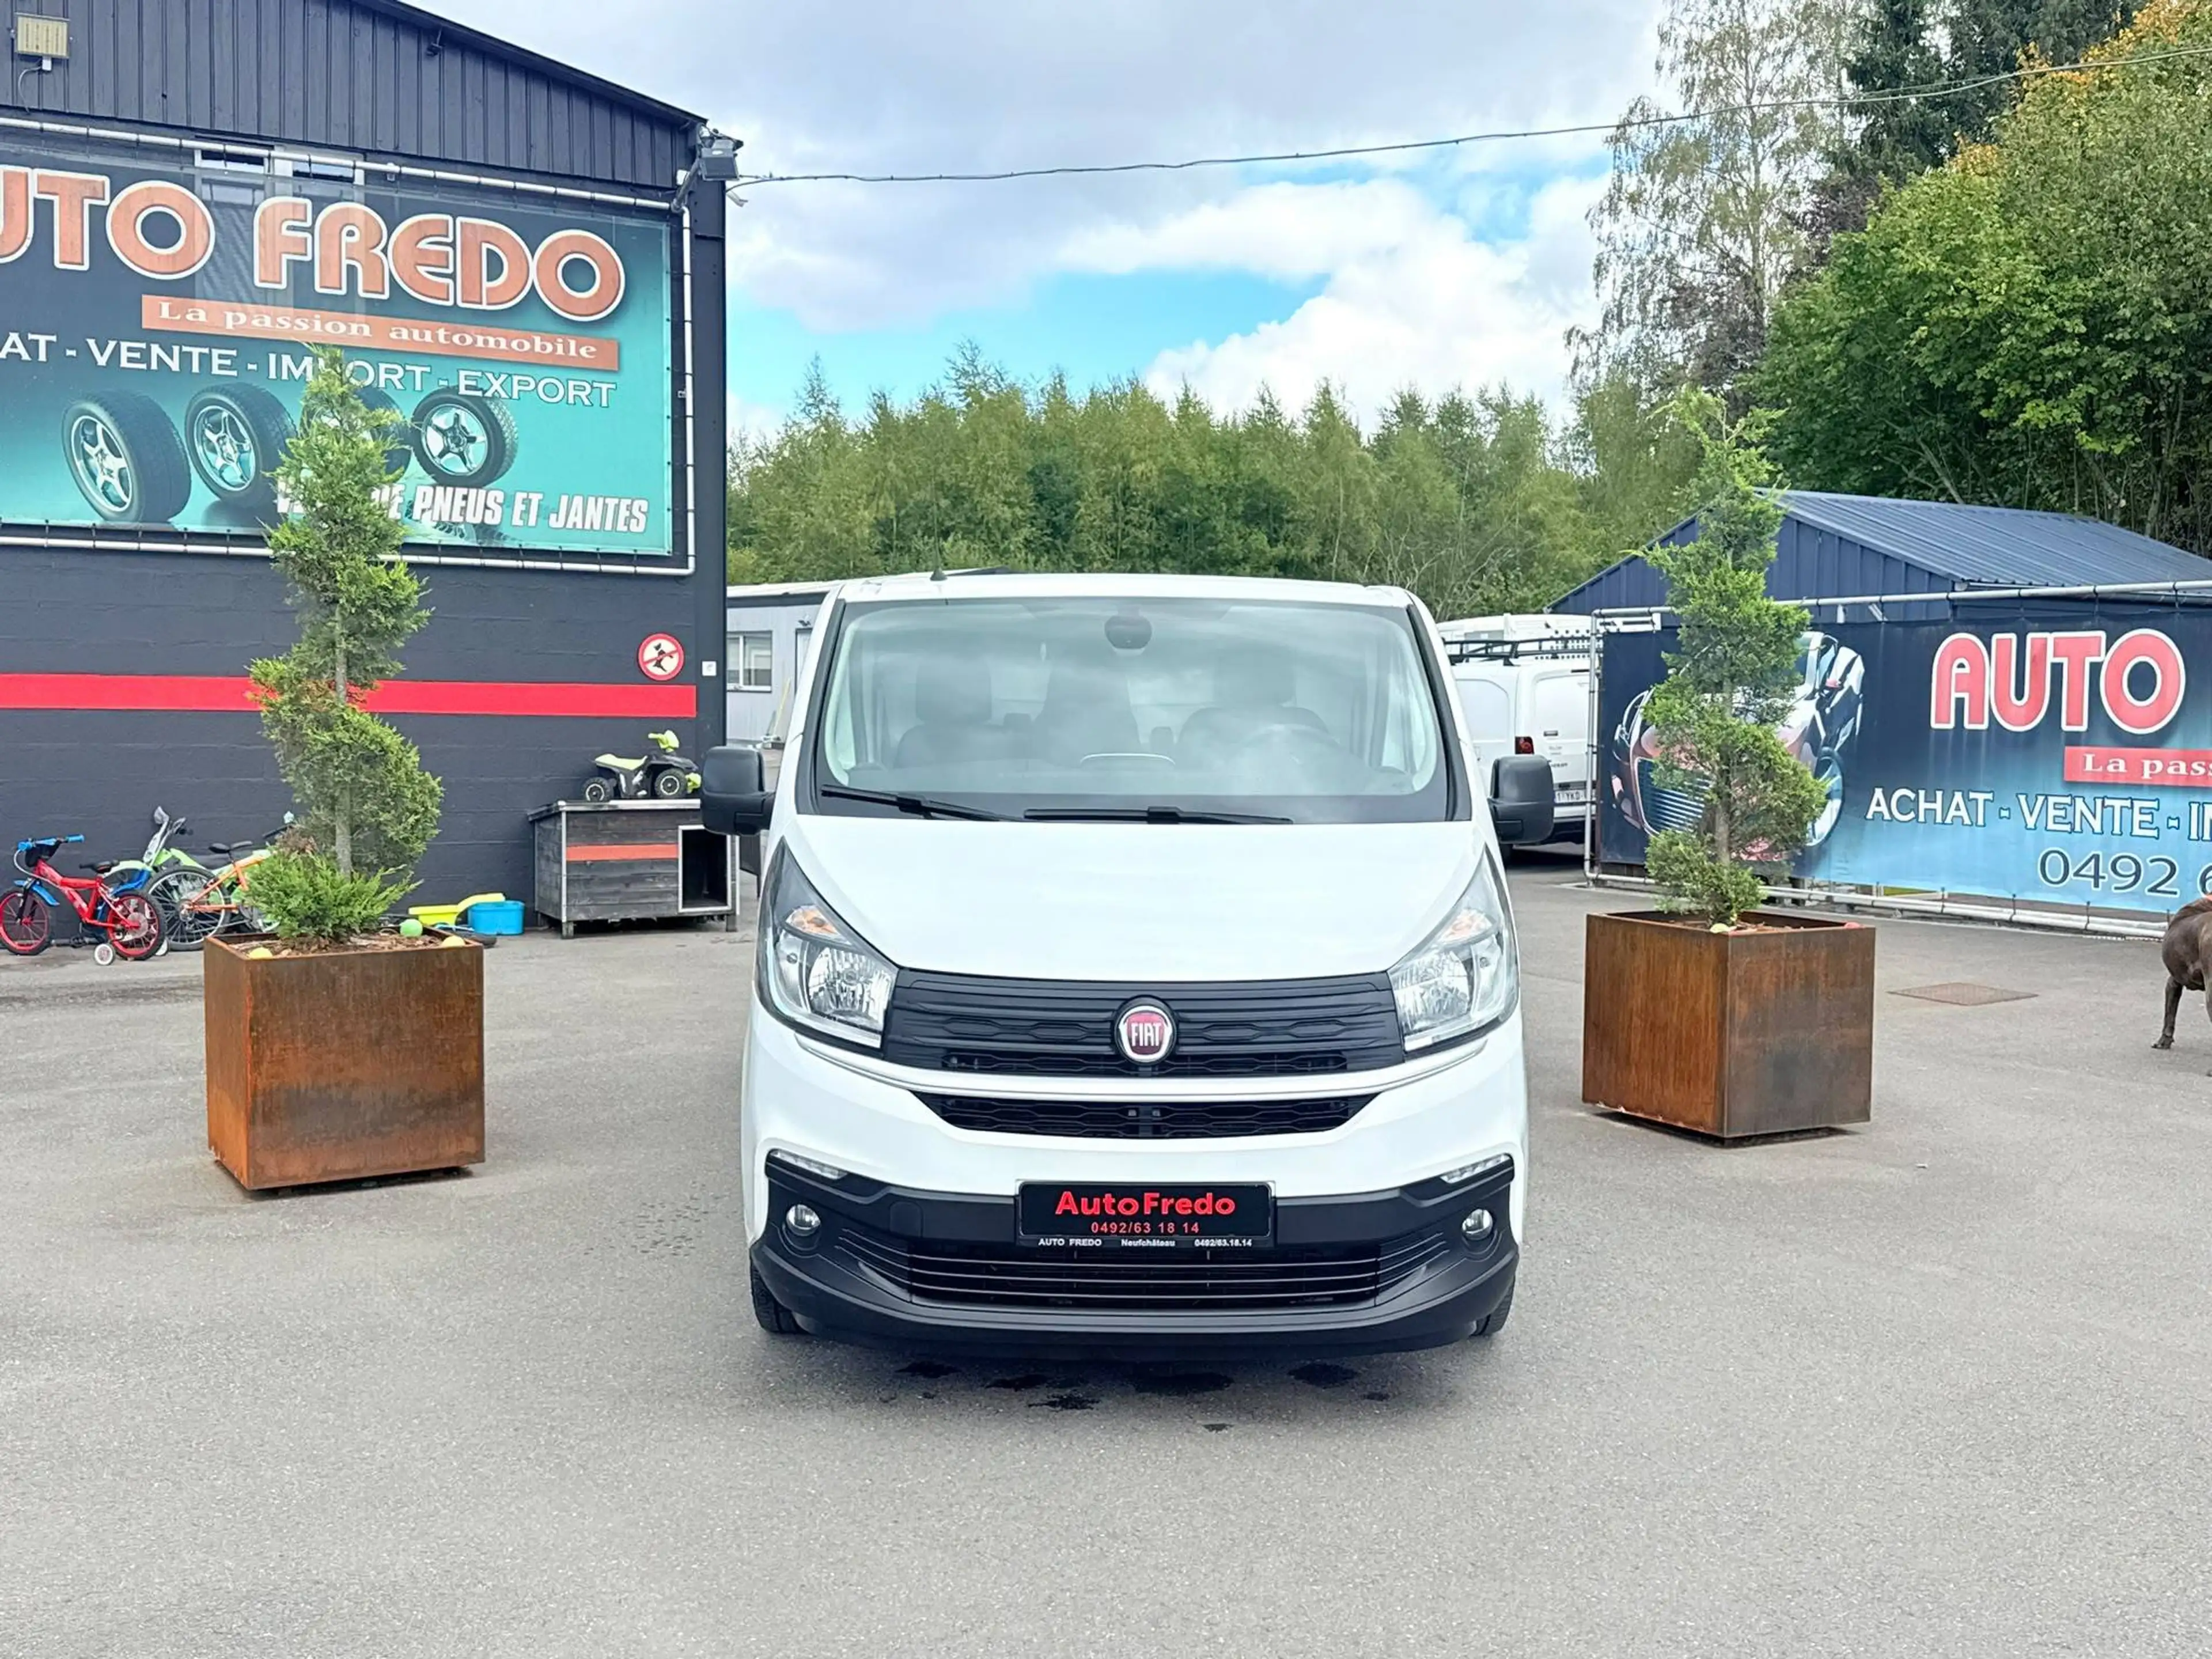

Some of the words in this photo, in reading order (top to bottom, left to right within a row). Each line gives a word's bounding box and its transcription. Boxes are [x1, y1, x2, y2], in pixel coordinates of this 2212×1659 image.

[253, 196, 626, 322] FREDO
[158, 301, 207, 323] La
[224, 309, 373, 339] passion
[388, 326, 598, 359] automobile
[86, 338, 238, 377] VENTE
[267, 352, 431, 391] IMORT
[458, 369, 617, 407] EXPORT
[412, 484, 505, 526] PNEUS
[511, 491, 544, 528] ET
[548, 494, 650, 533] JANTES
[1930, 628, 2186, 735] AUTO
[2083, 753, 2127, 773] La
[2141, 758, 2212, 779] pas
[1865, 787, 1995, 827] ACHAT
[2016, 793, 2160, 840] VENTE
[2038, 847, 2180, 896] 0492
[1131, 1022, 1162, 1047] FIAT
[1038, 1238, 1065, 1247] AUTO
[1069, 1238, 1103, 1247] FREDO
[1091, 1222, 1152, 1234] 0492/63
[1158, 1222, 1175, 1234] 18
[1182, 1222, 1200, 1234] 14
